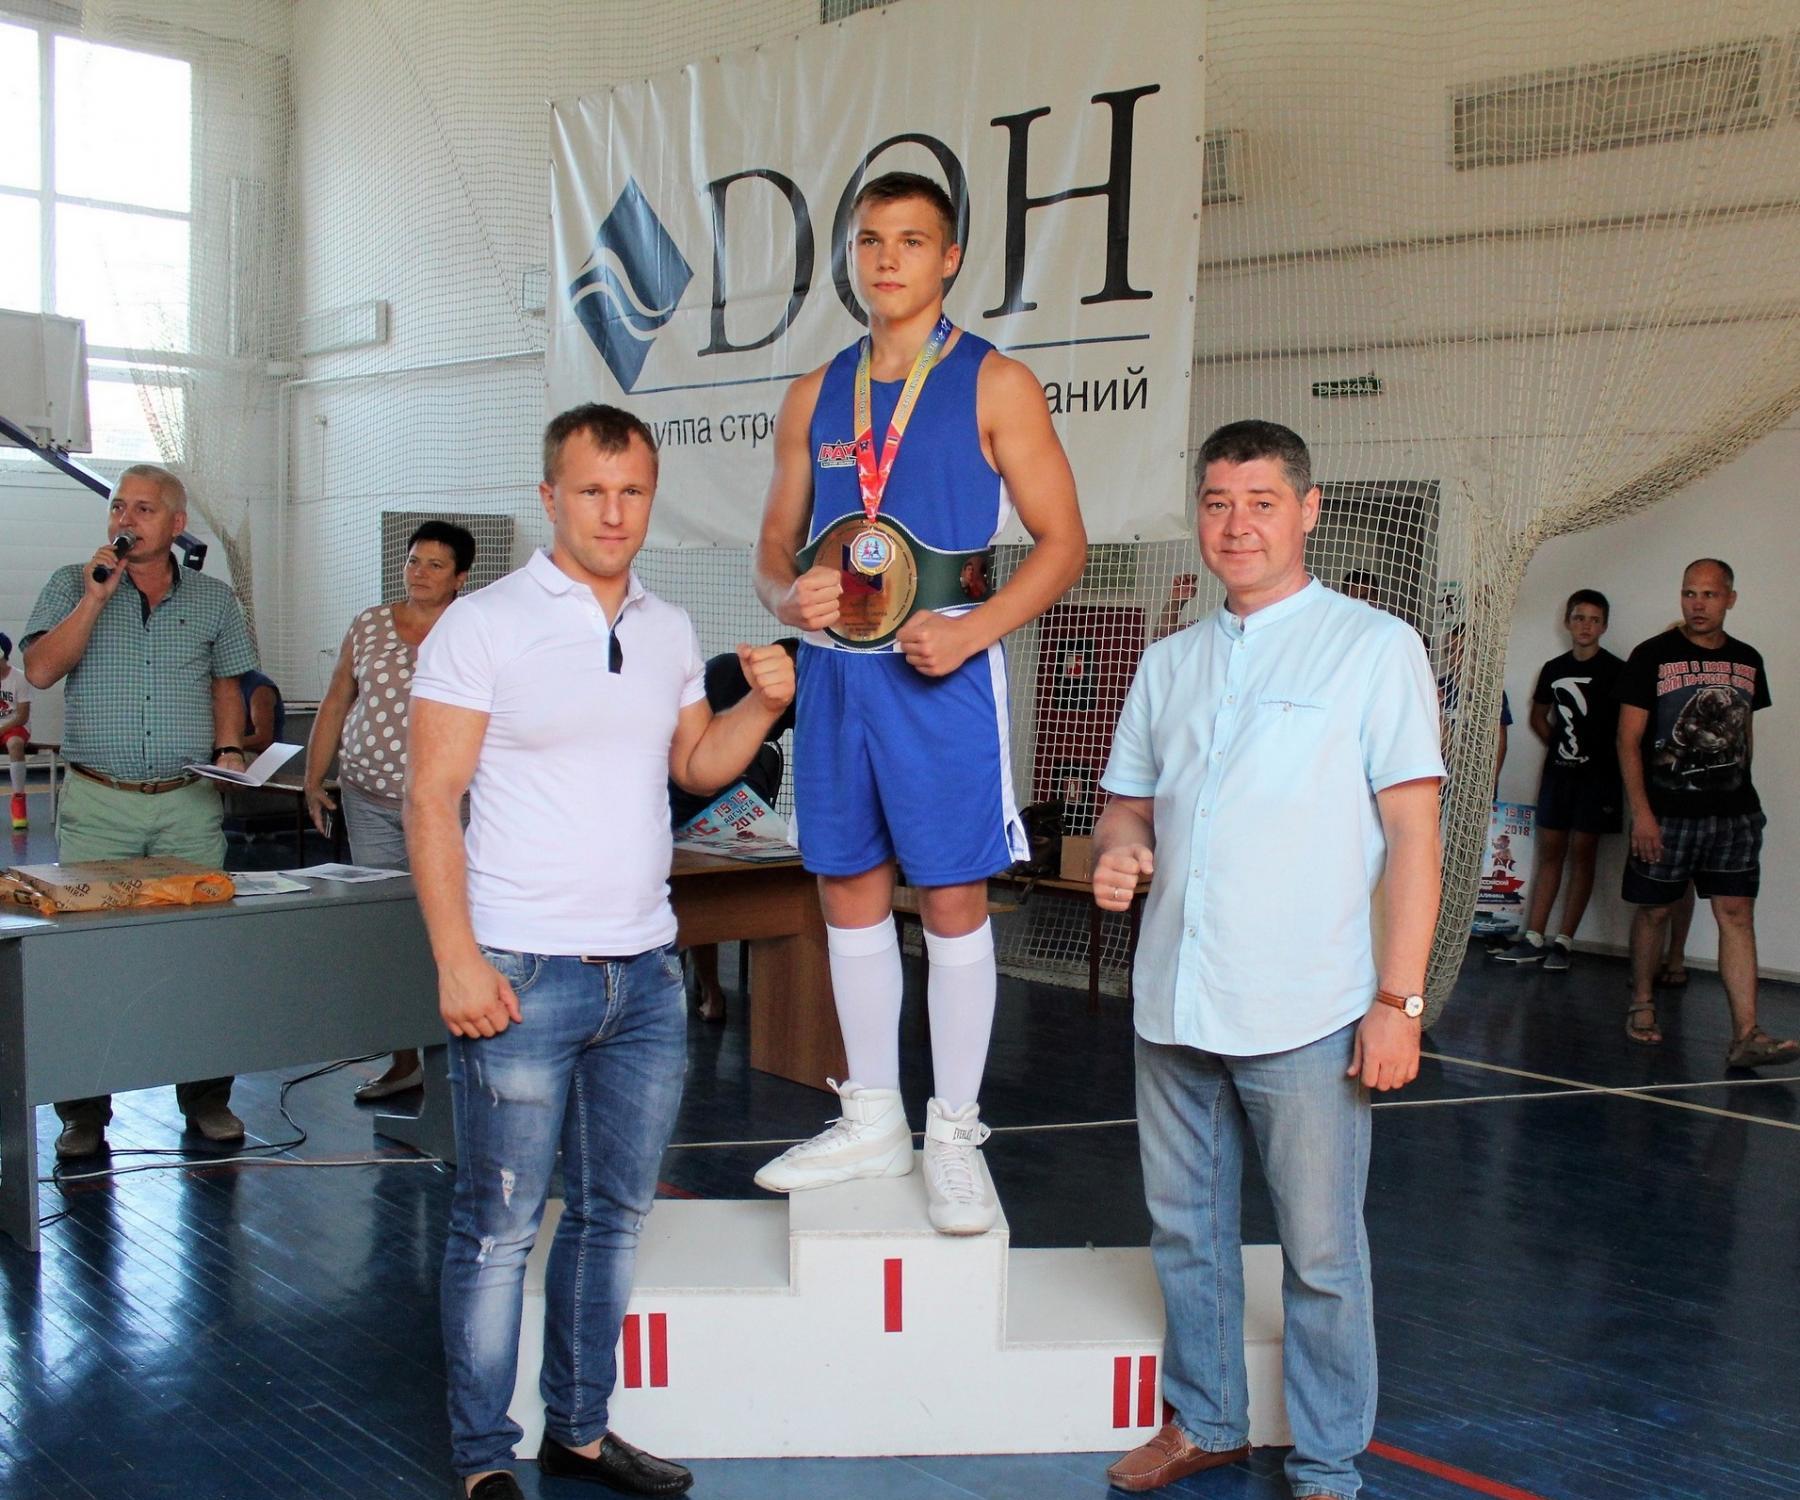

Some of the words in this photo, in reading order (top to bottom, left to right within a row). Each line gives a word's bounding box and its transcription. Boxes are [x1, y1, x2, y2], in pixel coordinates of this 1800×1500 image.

[645, 416, 712, 450] уппа
[719, 412, 776, 449] стр
[1043, 365, 1148, 415] аний
[723, 800, 755, 824] АВГУСТА
[731, 806, 766, 831] 2018
[1504, 823, 1531, 836] 2018
[1112, 1354, 1172, 1429] II
